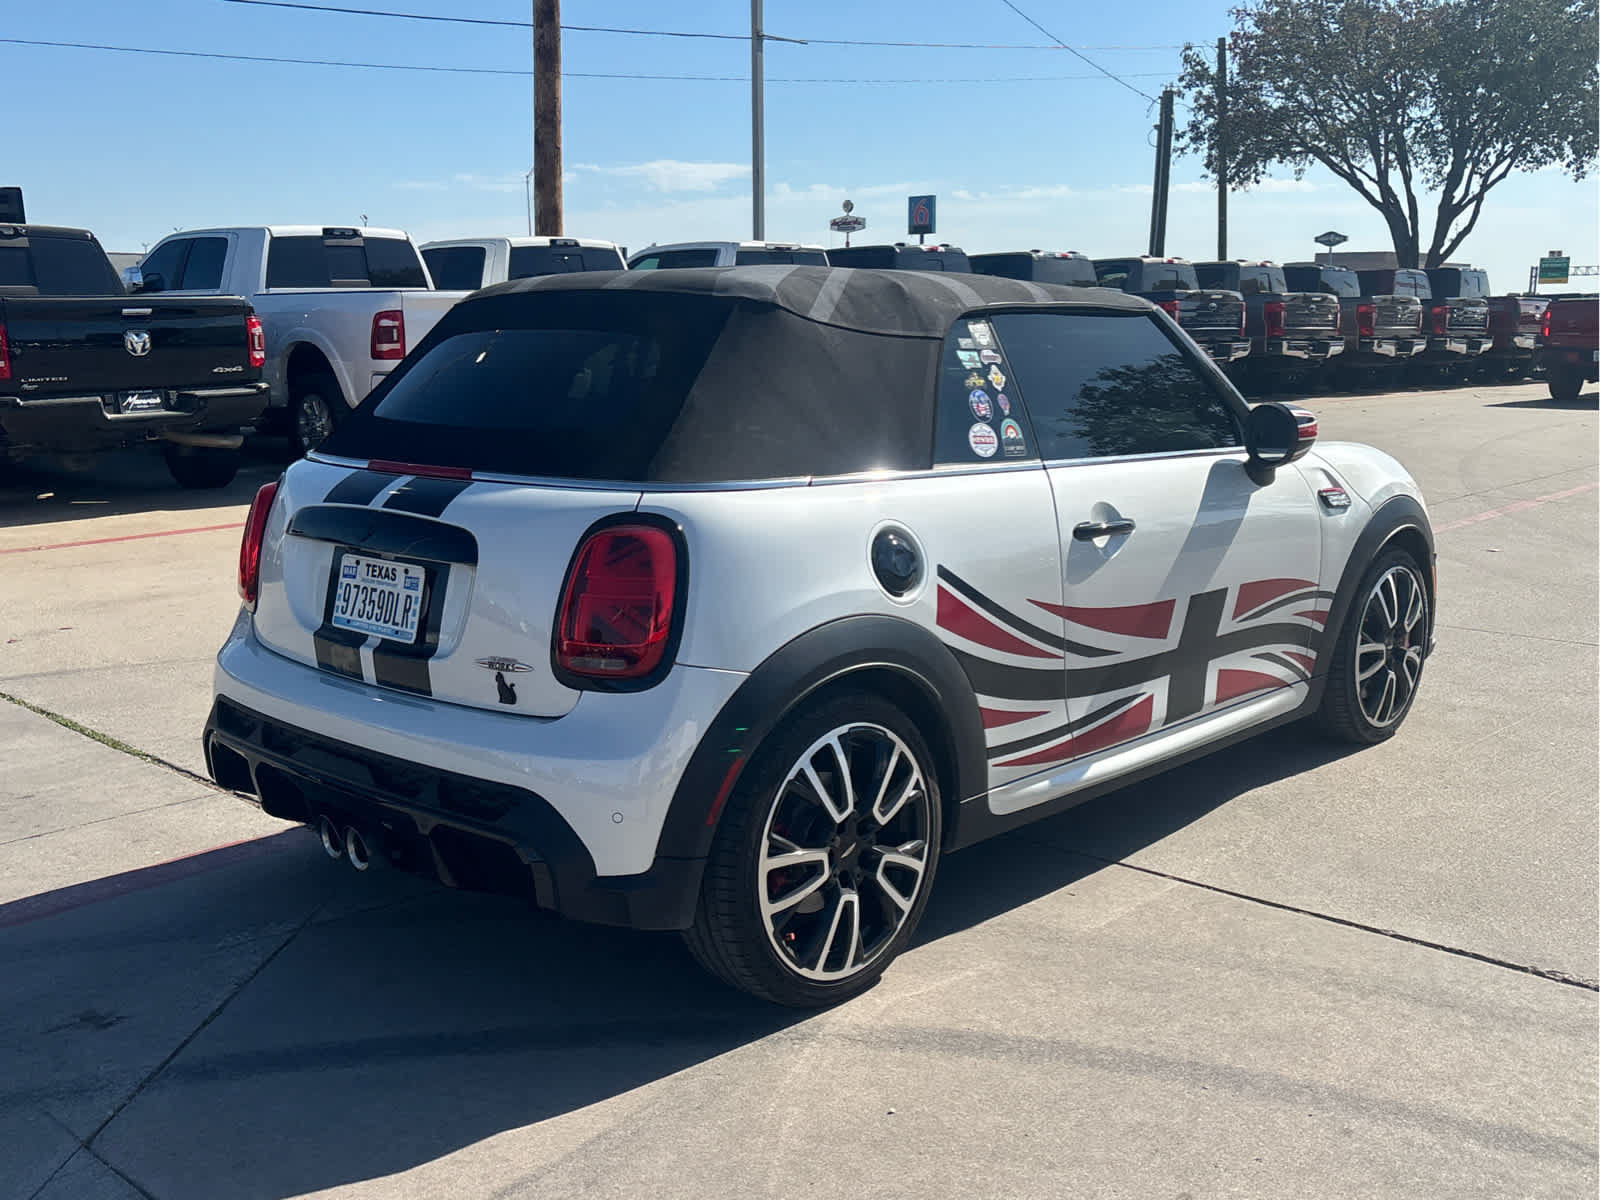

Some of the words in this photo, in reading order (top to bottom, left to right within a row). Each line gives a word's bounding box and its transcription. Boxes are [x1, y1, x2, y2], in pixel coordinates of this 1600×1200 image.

[913, 199, 929, 225] 6
[365, 563, 397, 581] TEXAS
[341, 583, 413, 629] 97359DLR
[488, 662, 515, 672] WORKS
